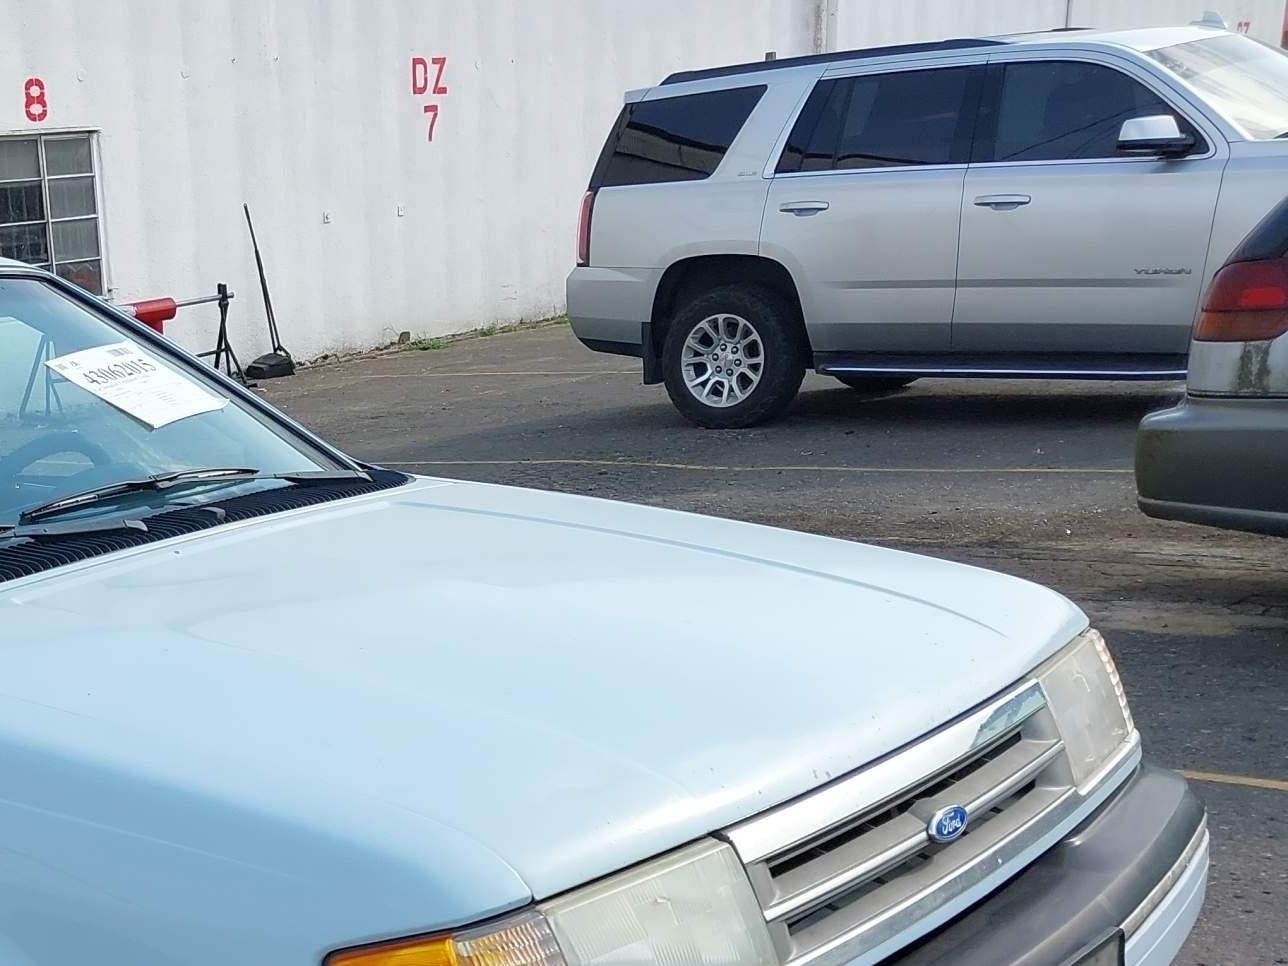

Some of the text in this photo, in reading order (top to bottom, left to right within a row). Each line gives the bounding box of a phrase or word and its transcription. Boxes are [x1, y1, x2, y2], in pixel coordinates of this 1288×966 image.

[411, 56, 448, 96] DZ
[23, 77, 48, 122] 8
[423, 104, 439, 142] 7
[82, 358, 157, 385] 43062015
